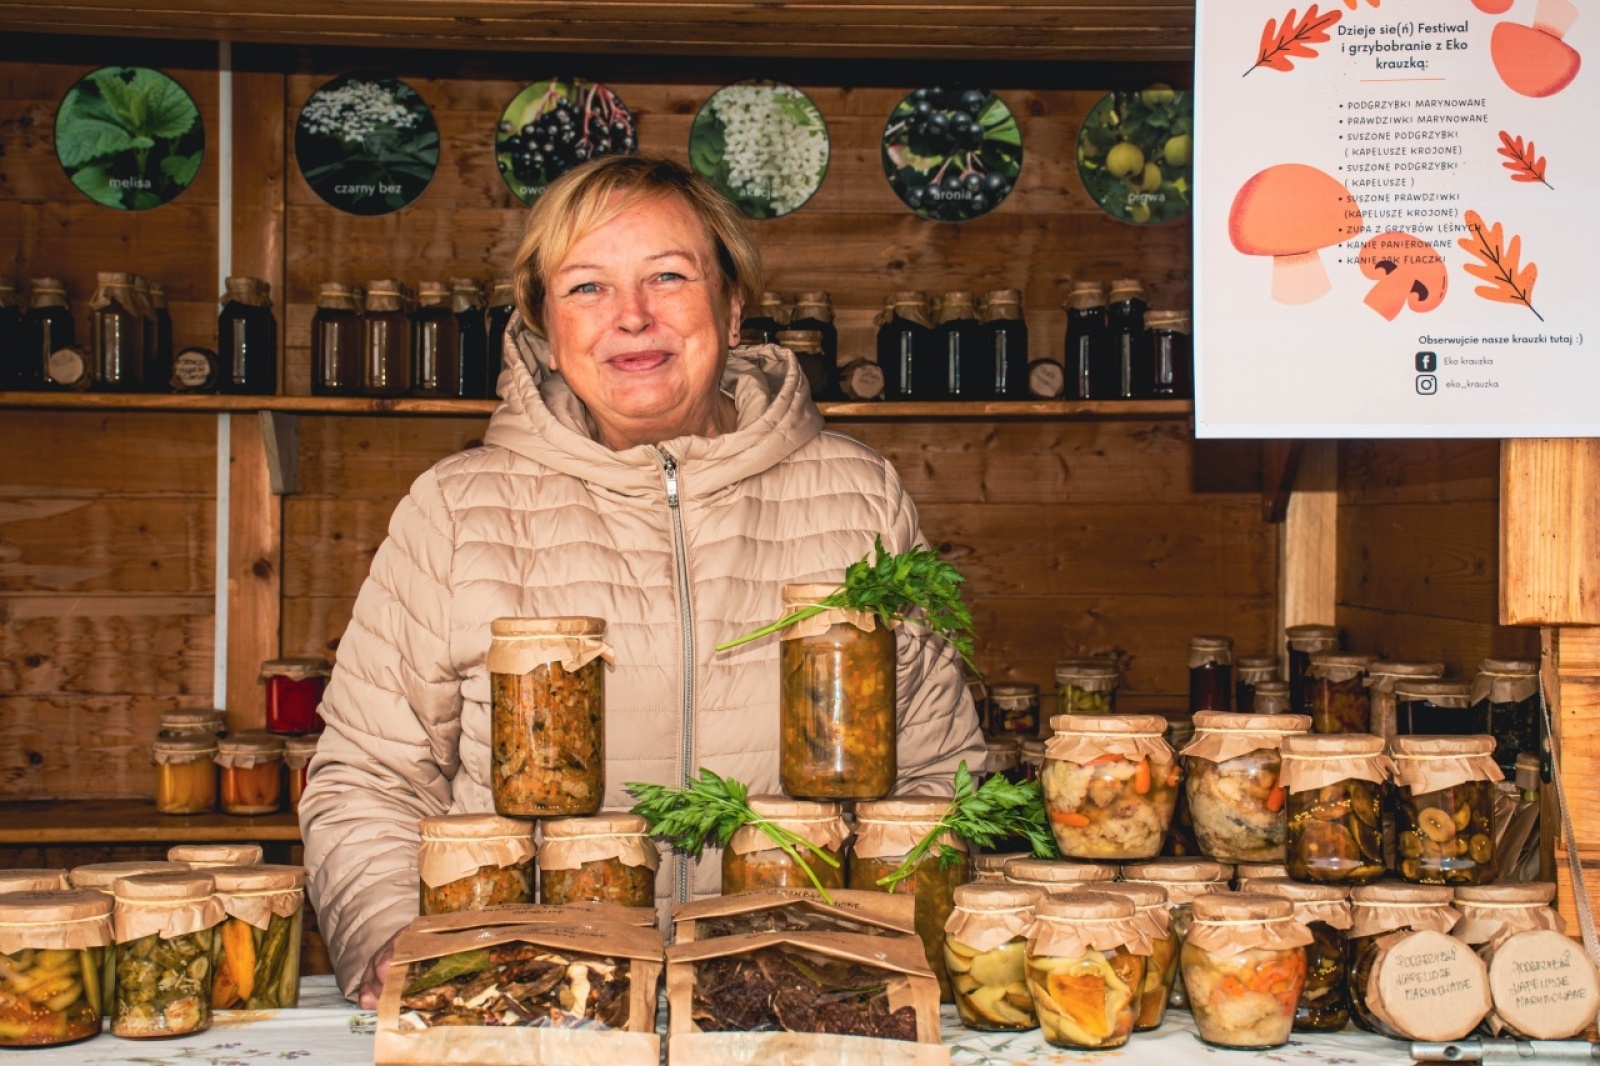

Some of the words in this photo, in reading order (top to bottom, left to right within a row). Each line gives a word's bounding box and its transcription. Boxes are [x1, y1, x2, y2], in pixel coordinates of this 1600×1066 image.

[1338, 25, 1376, 39] Dzieje
[1379, 22, 1415, 37] sie(ń)
[1418, 20, 1469, 34] Festiwal
[1341, 43, 1345, 53] i
[1349, 40, 1432, 56] grzybobranie
[1435, 43, 1442, 51] z
[1445, 39, 1469, 51] Eko
[1375, 57, 1429, 71] krauzką:
[1347, 100, 1411, 110] PODGRZYBKI
[1415, 98, 1487, 108] MARYNOWANE
[1347, 116, 1414, 126] PRAWDZIWKI
[1417, 114, 1489, 124] MARYNOWANE
[1346, 132, 1391, 141] SUSZONE
[1394, 131, 1459, 140] PODGRZYBKI
[1410, 145, 1463, 156] KROJONE)
[1346, 163, 1391, 172] SUSZONE
[1394, 161, 1459, 171] PODGRZYBKI
[109, 177, 152, 189] melisa
[334, 184, 375, 196] czarny
[379, 182, 402, 194] bez
[519, 186, 546, 195] owo
[933, 188, 972, 200] aronia
[1128, 191, 1165, 205] pigwa
[1346, 194, 1390, 203] SUSZONE
[1394, 192, 1460, 202] PRAWDZIWKI
[1344, 209, 1403, 219] (KAPELUSZE
[1406, 208, 1459, 218] KROJONE)
[1346, 224, 1372, 234] ZUPA
[1375, 224, 1382, 234] Z
[1384, 221, 1434, 234] GRZYBÓW
[1437, 221, 1481, 232] LEŚNYCH
[1346, 240, 1378, 250] KANIE
[1380, 239, 1453, 249] PANIEROWANE
[1346, 255, 1377, 265] KANIE
[1403, 255, 1446, 265] FLACZKI
[1418, 335, 1480, 347] Obserwujcie
[1482, 335, 1509, 344] nasze
[1512, 334, 1547, 344] krauzki
[1549, 334, 1573, 346] tutaj
[1443, 356, 1459, 366] Eko
[1461, 356, 1494, 366] krauzka
[1445, 378, 1500, 390] eko_krauzka
